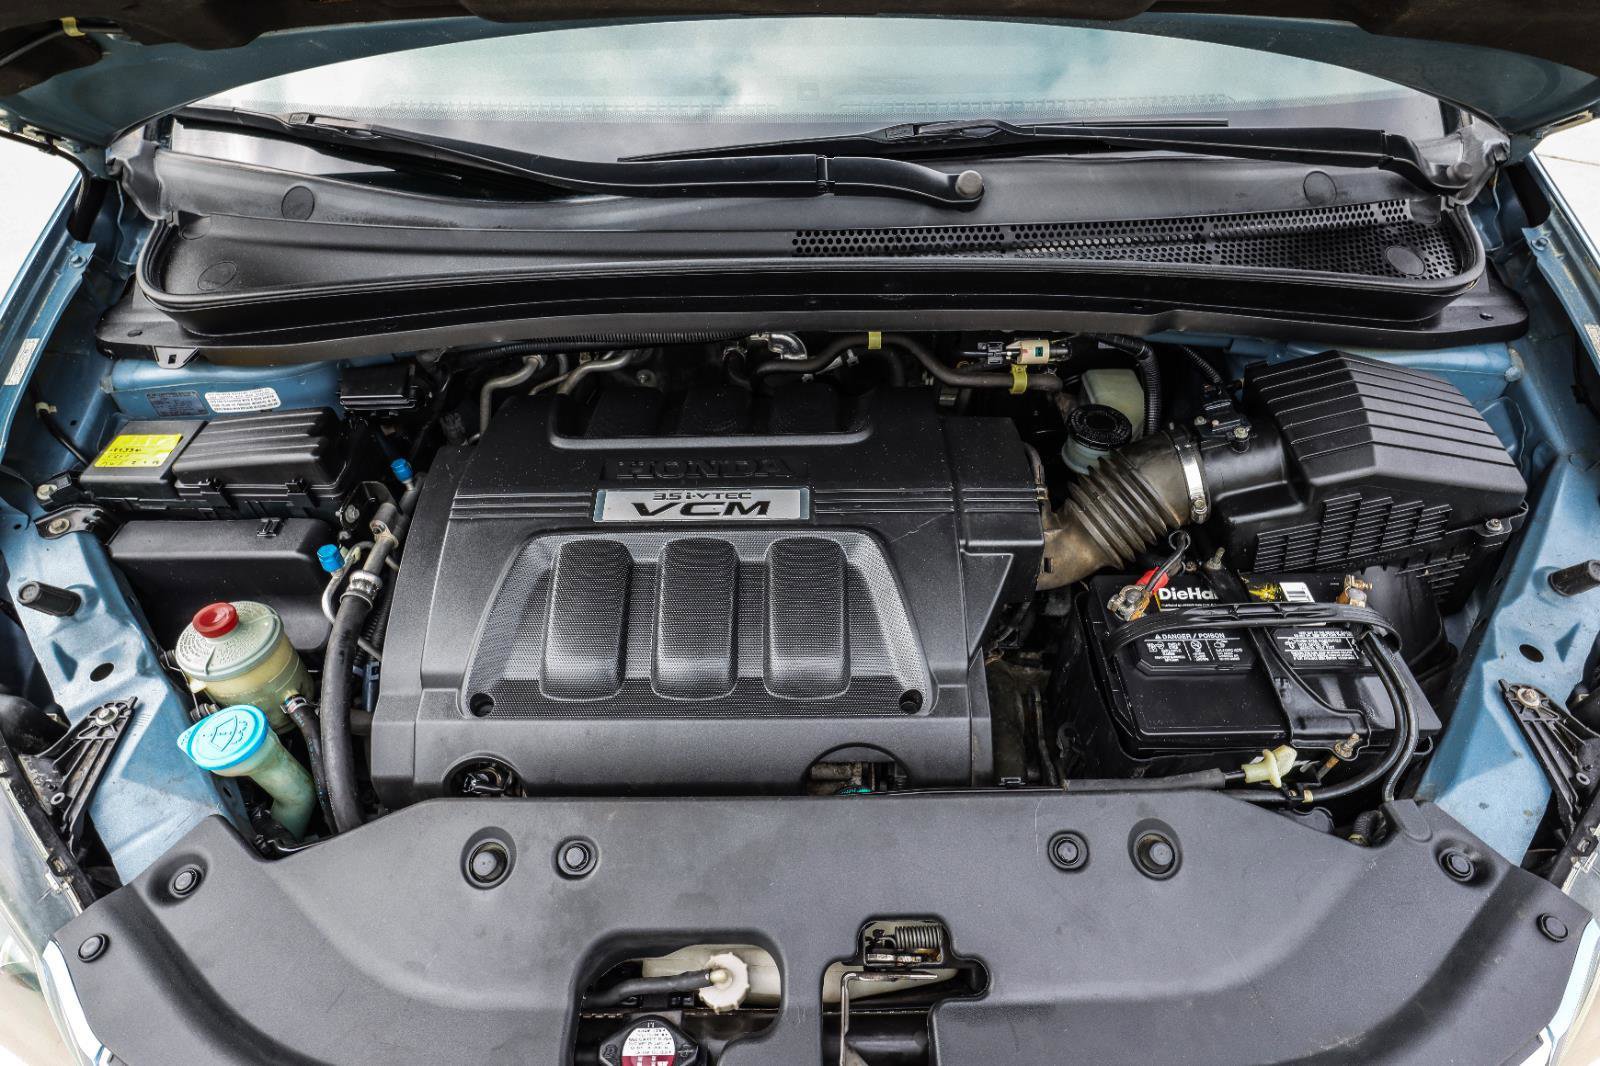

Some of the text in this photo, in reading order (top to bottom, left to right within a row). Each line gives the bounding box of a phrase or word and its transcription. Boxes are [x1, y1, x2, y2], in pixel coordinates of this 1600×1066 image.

[616, 460, 793, 479] HONDA
[652, 492, 682, 501] 3.5
[631, 501, 771, 517] VCM
[1158, 587, 1218, 600] DieHa
